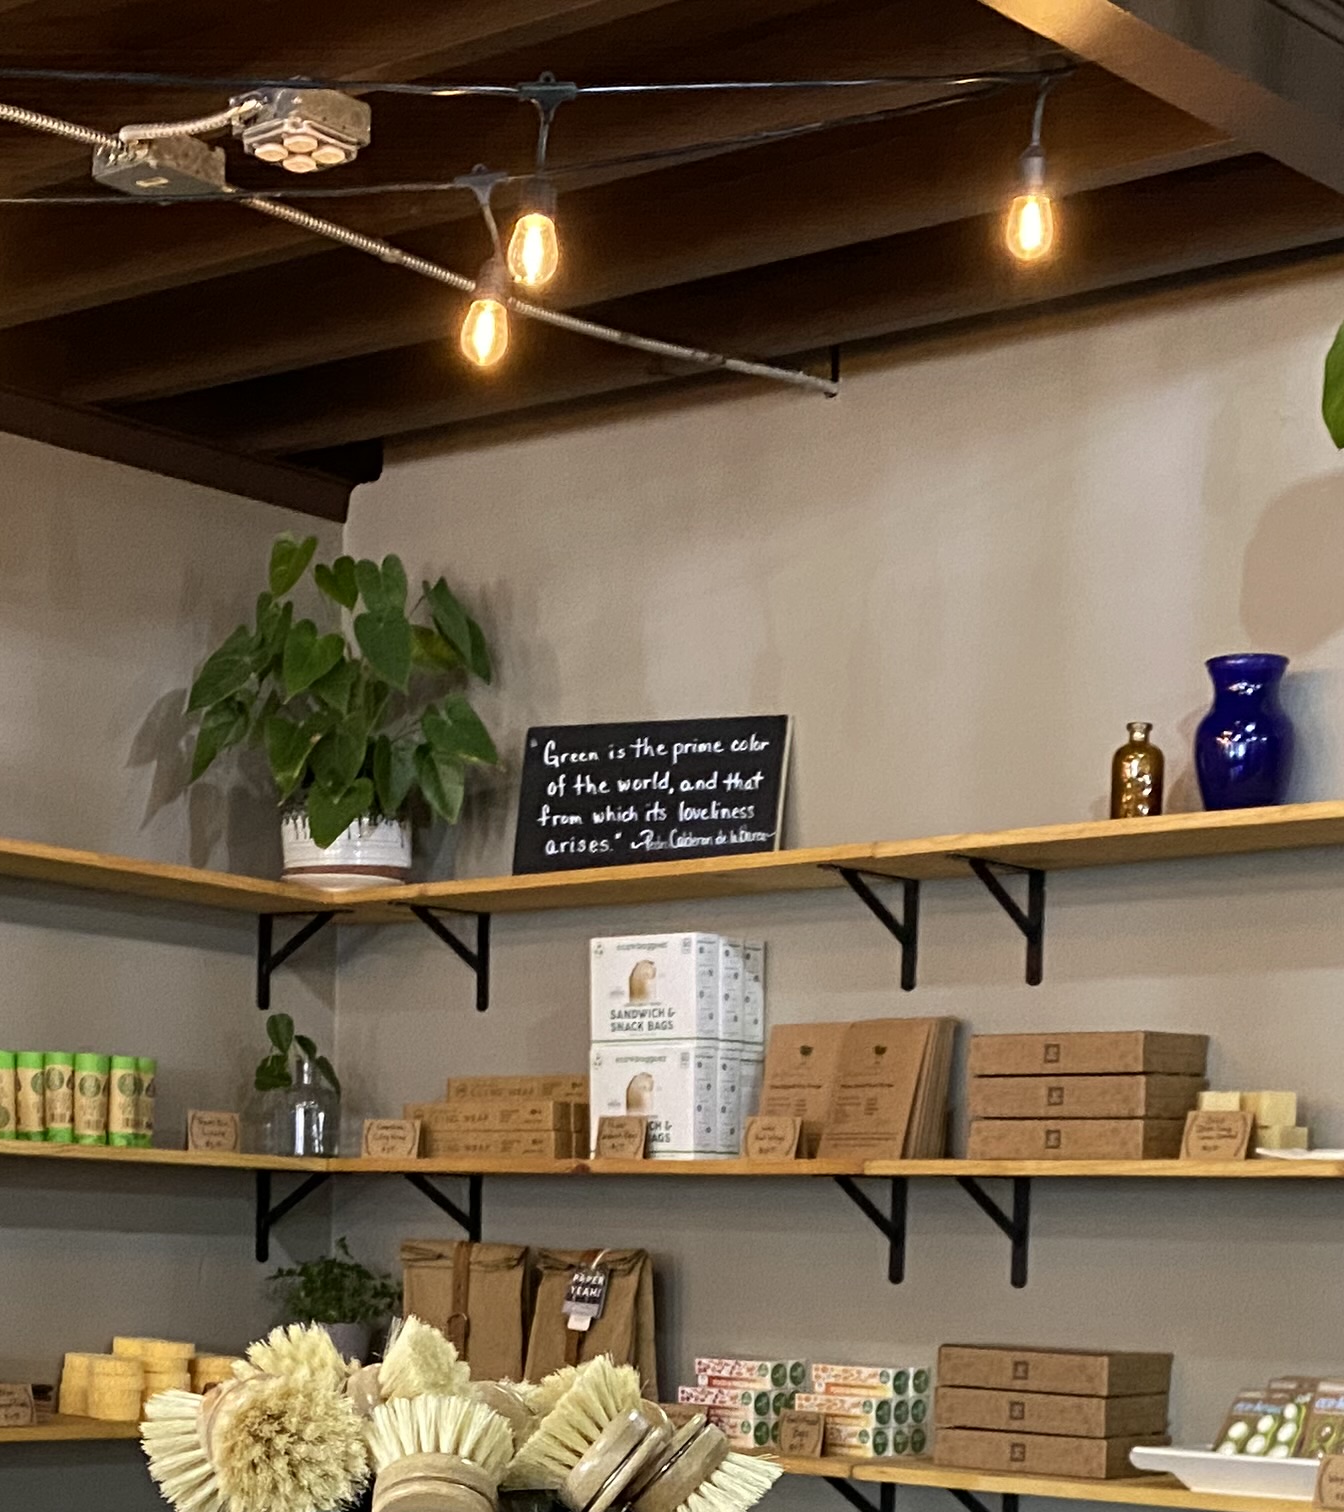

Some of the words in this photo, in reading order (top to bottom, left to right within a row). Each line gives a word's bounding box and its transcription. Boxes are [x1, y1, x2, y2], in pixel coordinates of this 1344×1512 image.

[608, 744, 626, 760] is
[629, 736, 669, 759] the
[673, 738, 724, 764] prime
[730, 733, 770, 752] color
[546, 774, 567, 798] of
[572, 773, 611, 796] the
[616, 771, 675, 796] world,
[680, 774, 718, 792] and
[722, 771, 765, 792] that
[536, 803, 584, 828] from
[592, 805, 638, 824] which
[644, 802, 668, 822] its
[678, 801, 756, 822] loveliness
[609, 1008, 665, 1020] SANDWICH
[610, 1022, 644, 1033] SNACK
[647, 1020, 674, 1032] BAGS
[650, 1132, 671, 1144] AGS
[572, 1272, 605, 1286] PAPER
[570, 1285, 602, 1298] YEAH!
